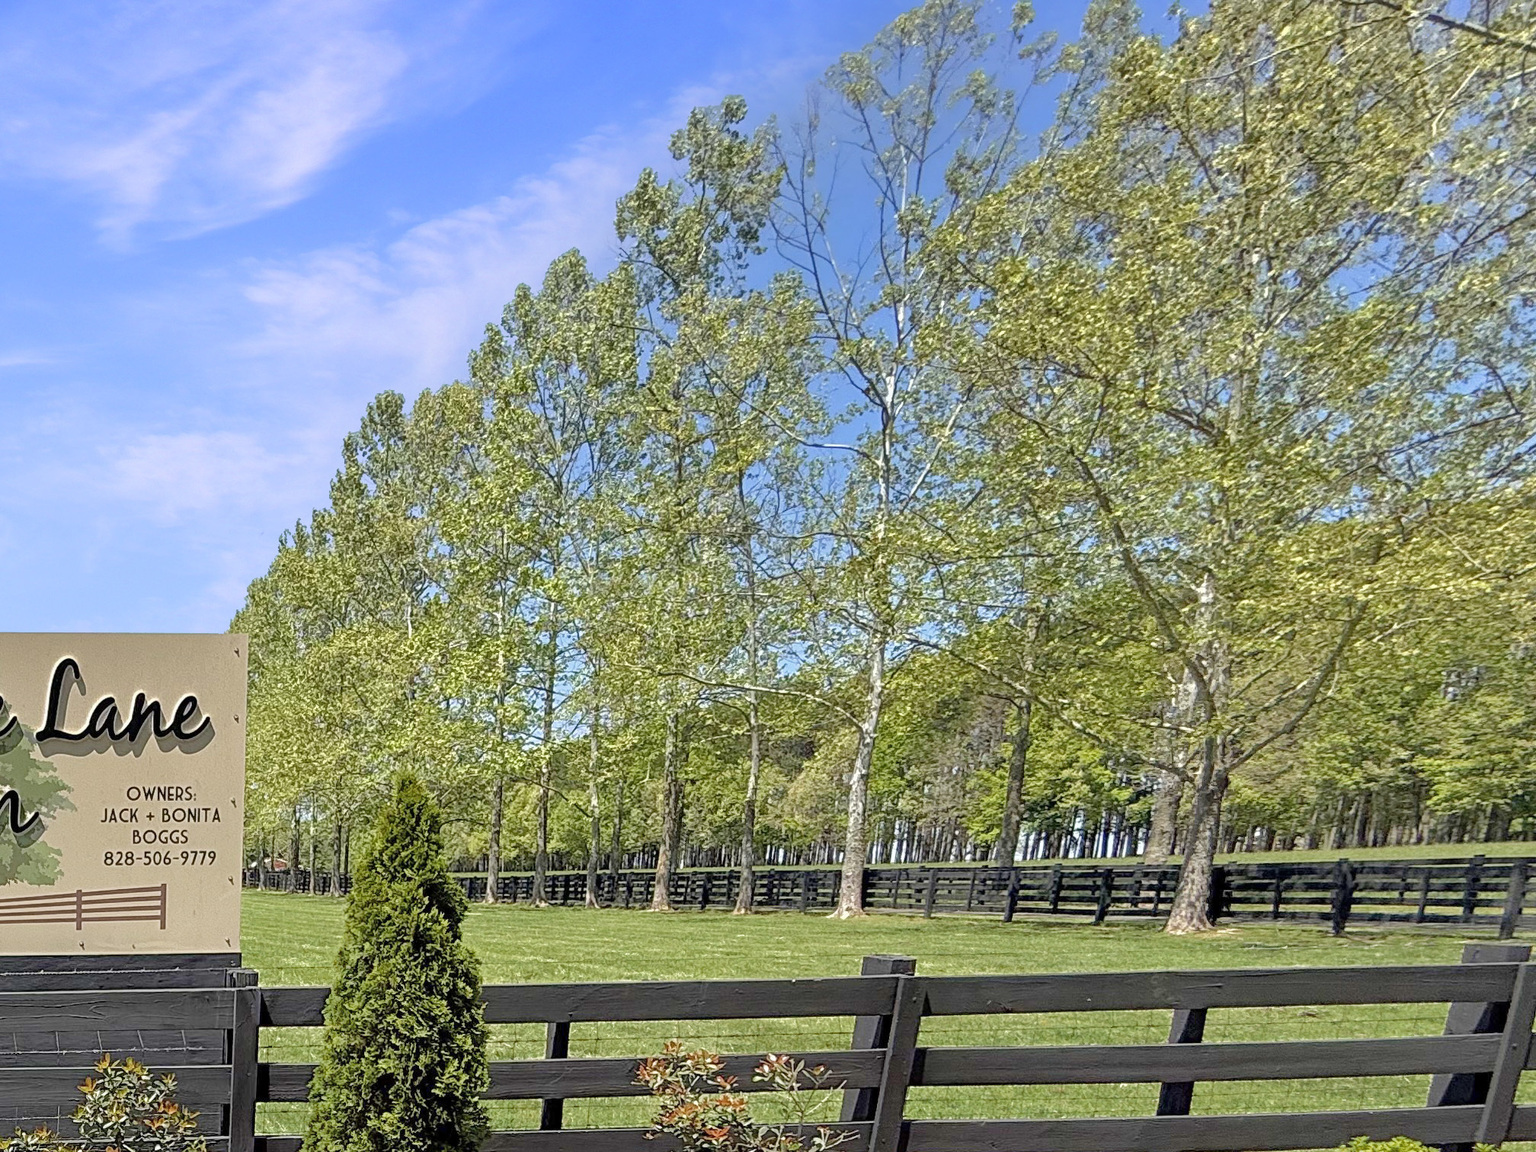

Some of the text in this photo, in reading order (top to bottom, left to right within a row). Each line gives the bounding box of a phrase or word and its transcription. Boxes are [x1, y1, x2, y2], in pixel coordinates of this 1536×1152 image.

[35, 657, 212, 744] Lane
[126, 786, 197, 801] OWNERS:
[100, 807, 222, 823] JACK + BONITA
[132, 829, 189, 845] BOGGS
[103, 850, 217, 866] 828-506-9779
